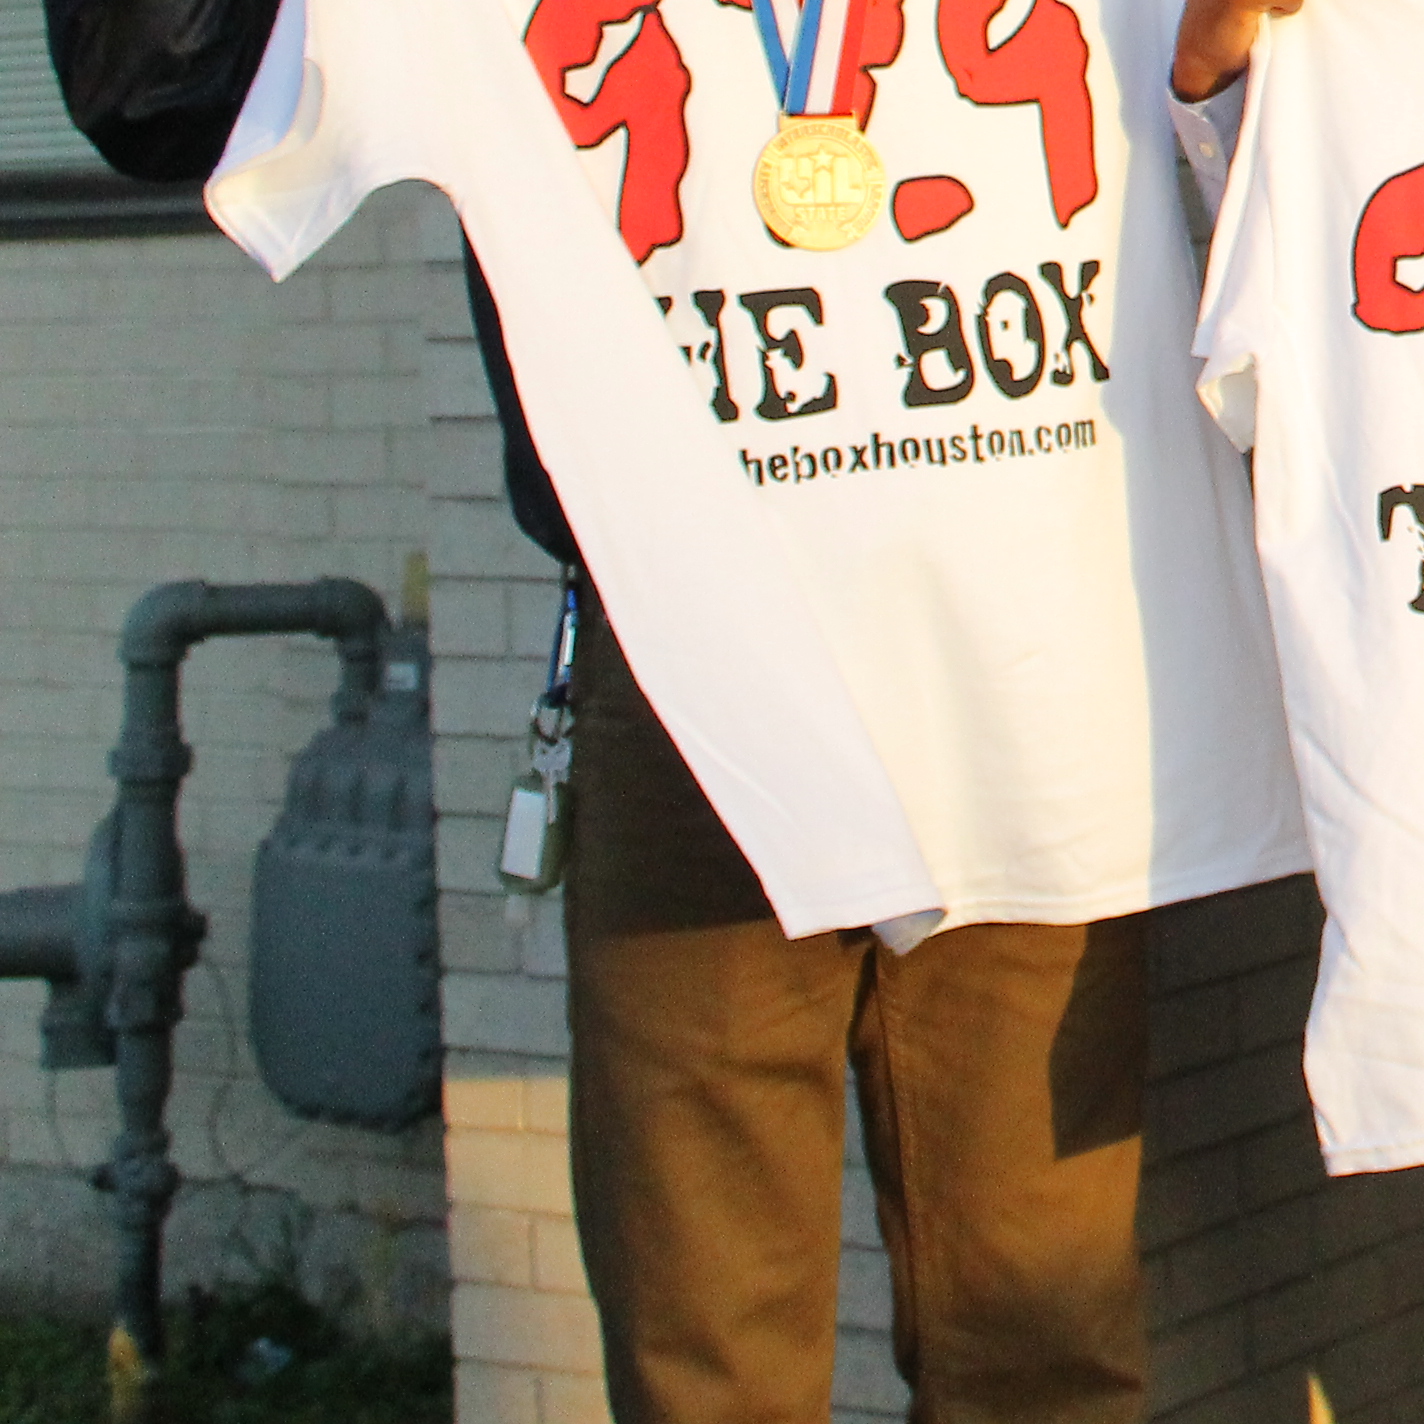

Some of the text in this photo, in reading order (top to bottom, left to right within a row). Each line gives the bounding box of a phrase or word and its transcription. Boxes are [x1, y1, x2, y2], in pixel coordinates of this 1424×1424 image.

[794, 206, 848, 223] STATE
[655, 260, 1111, 423] HE BOX
[738, 419, 1097, 486] heboxhouston.com
